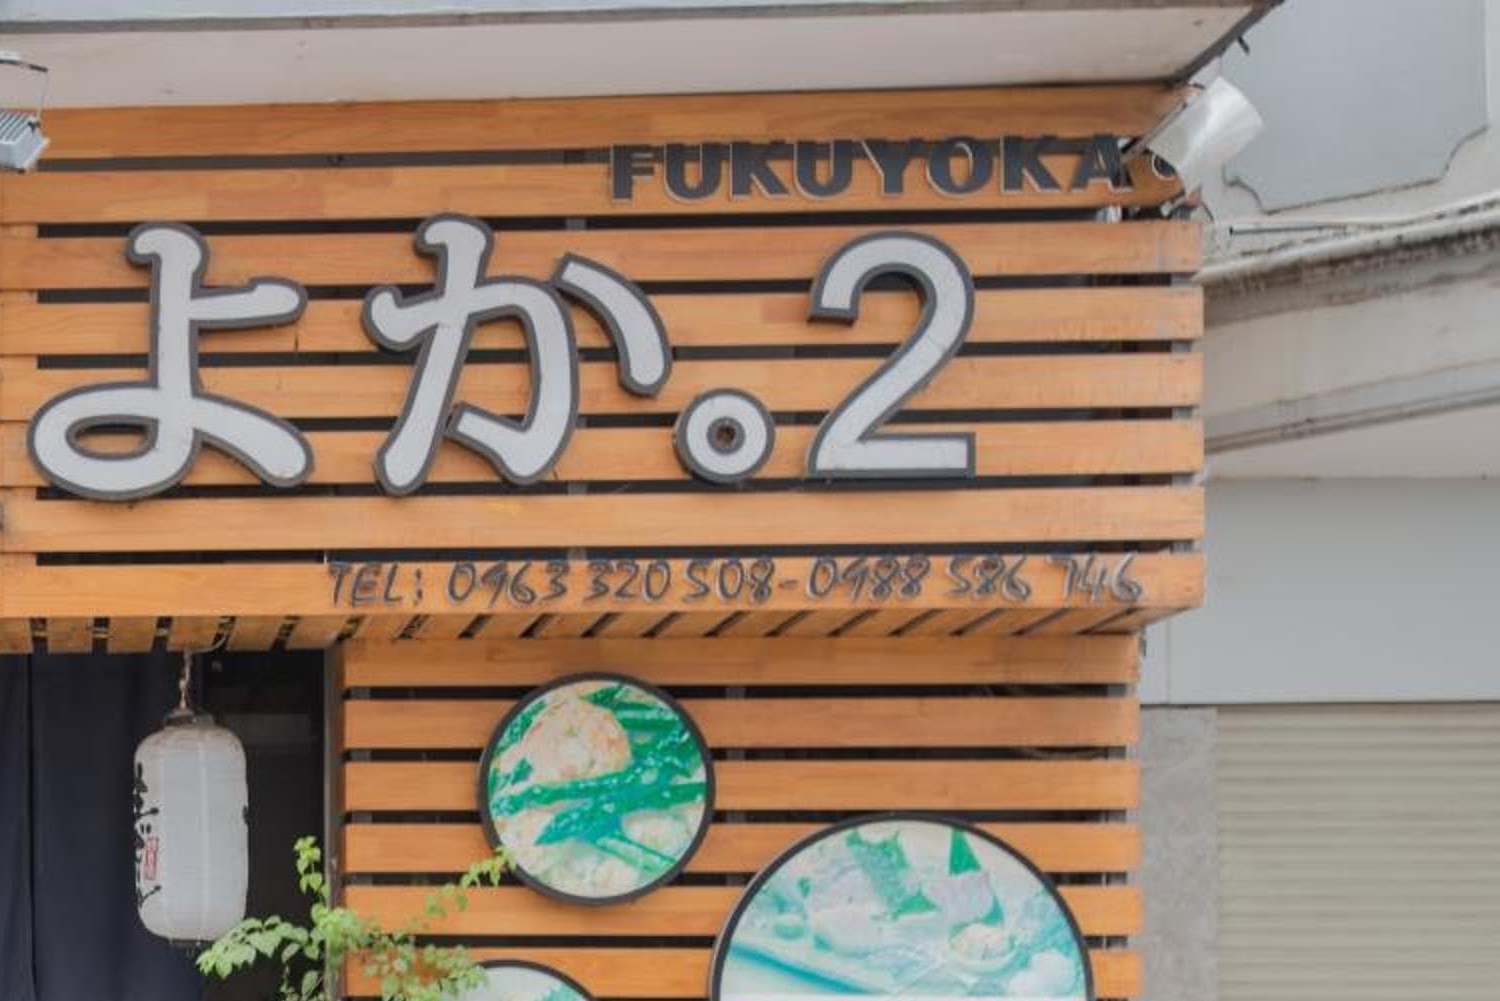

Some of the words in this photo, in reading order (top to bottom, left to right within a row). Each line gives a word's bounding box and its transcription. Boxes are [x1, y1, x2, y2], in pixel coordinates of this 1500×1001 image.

[609, 134, 1134, 200] FUKUYOKA
[448, 557, 570, 608] 0963
[583, 557, 671, 602] 320
